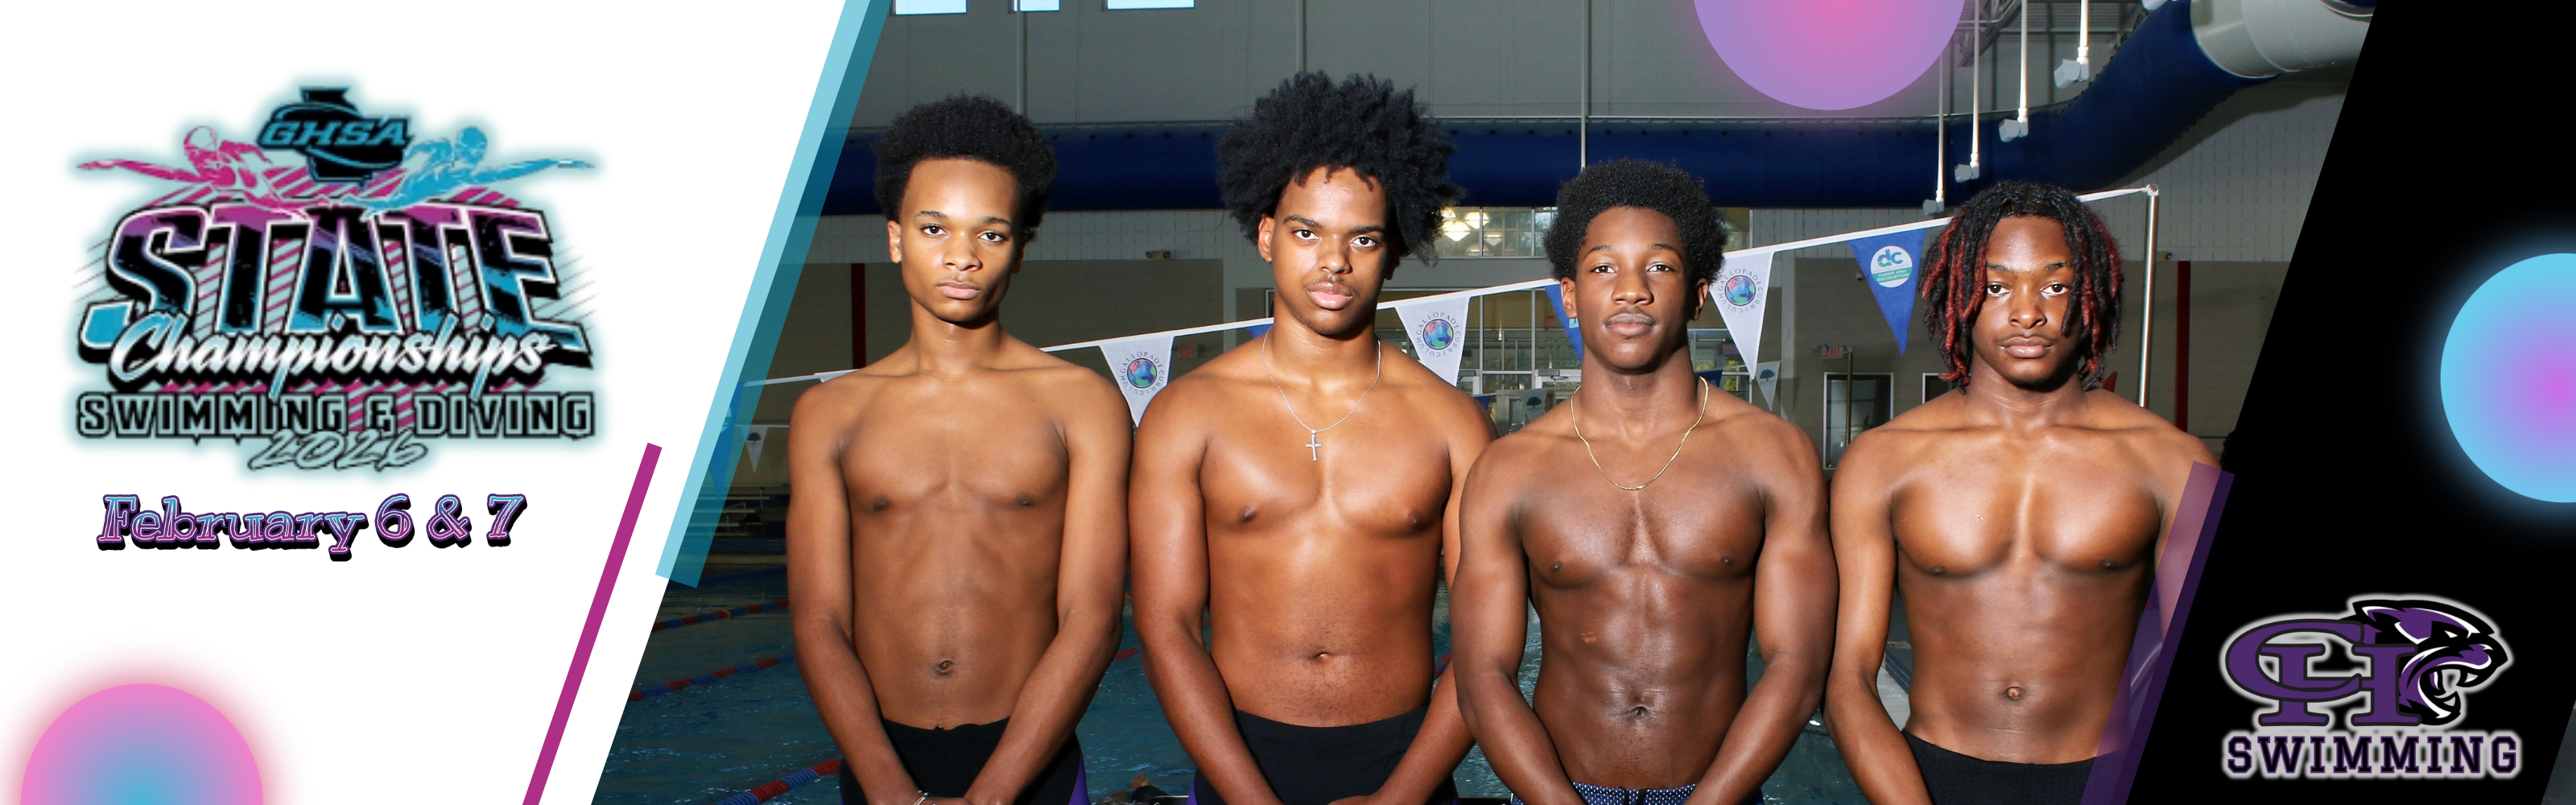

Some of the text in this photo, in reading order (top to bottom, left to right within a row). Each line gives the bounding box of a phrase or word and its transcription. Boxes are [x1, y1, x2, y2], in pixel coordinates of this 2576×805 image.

[1877, 249, 1904, 267] dc
[1718, 268, 1763, 313] GALLOPADE CURRICULUM
[1876, 273, 1909, 282] RECREATION
[1416, 312, 1460, 357] GALLOPADE CURRICULUM
[1179, 345, 1195, 357] EXIT
[1121, 351, 1165, 395] GALLOPADE CURRICULUM
